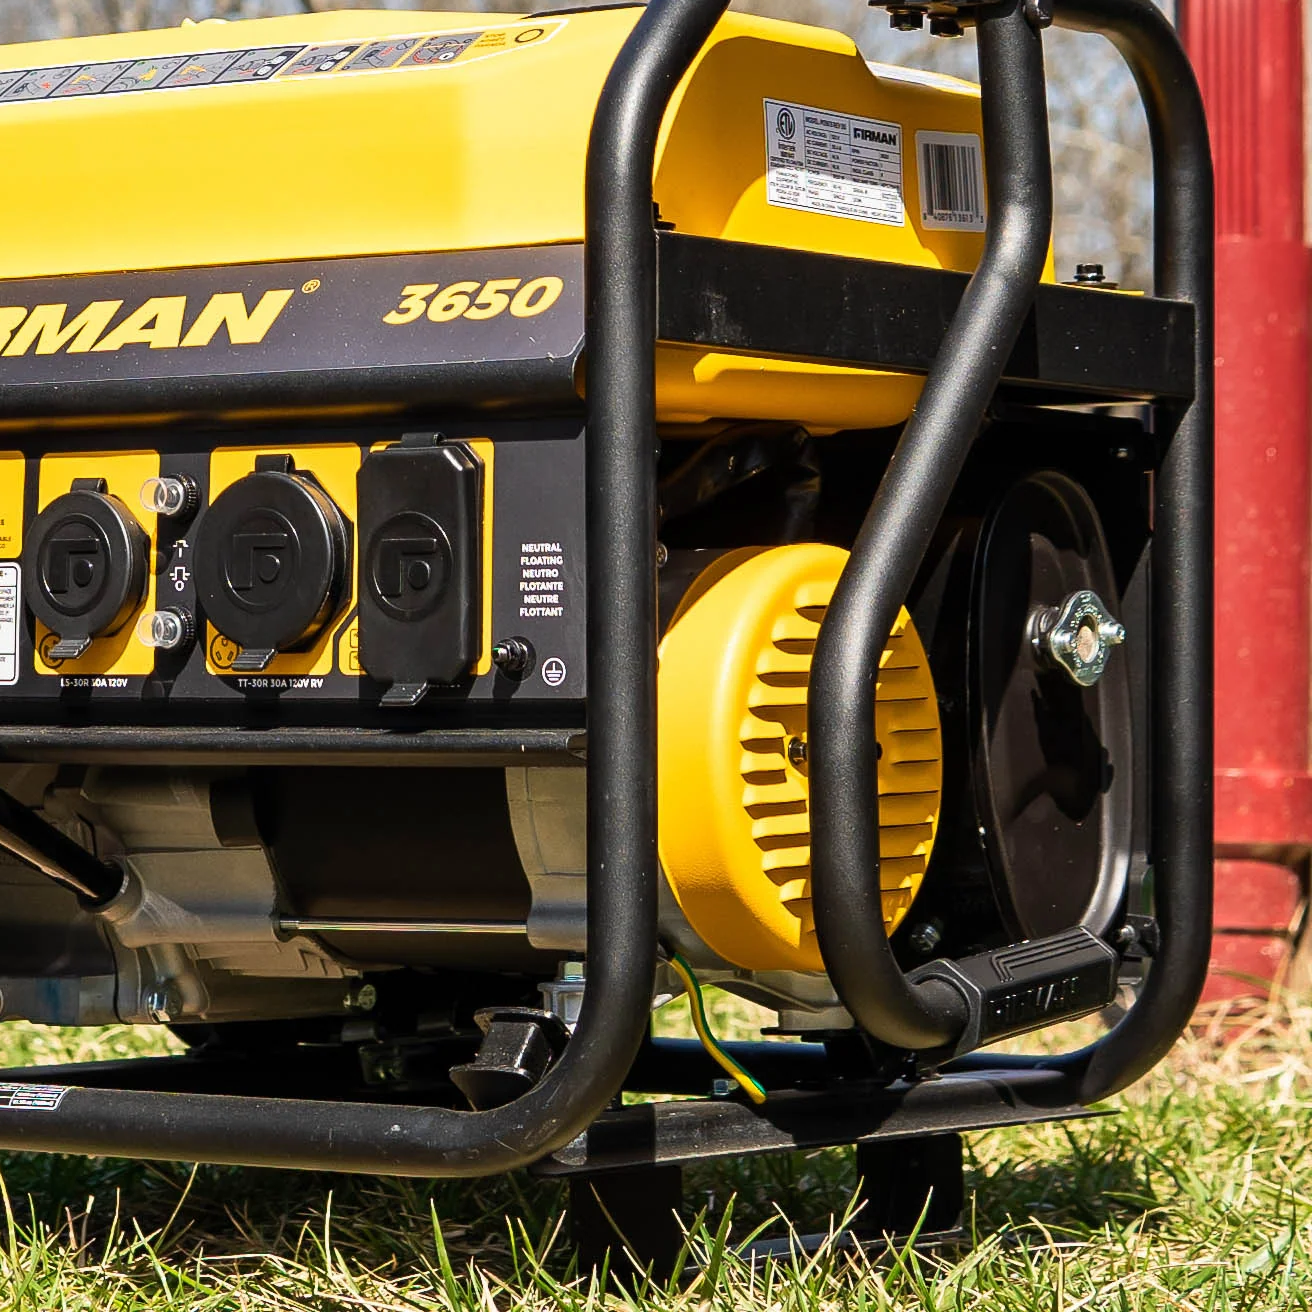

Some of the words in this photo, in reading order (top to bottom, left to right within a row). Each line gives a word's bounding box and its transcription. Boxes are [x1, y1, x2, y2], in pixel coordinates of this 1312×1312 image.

[853, 127, 897, 146] FIRMAN
[382, 276, 564, 325] 3650
[521, 542, 562, 553] NEUTRAL
[520, 555, 564, 566] FLOATING
[522, 568, 559, 579] NEUTRO
[519, 581, 564, 591] FLOTANTE
[523, 594, 559, 604] NEUTRE
[519, 607, 564, 617] FLOTTANT
[60, 677, 89, 688] L5-30R
[91, 677, 108, 688] 30A
[108, 678, 128, 688] 120V
[237, 678, 269, 688] TT-30R
[270, 678, 288, 688] 30A
[288, 678, 310, 688] 120V
[310, 678, 324, 688] RV
